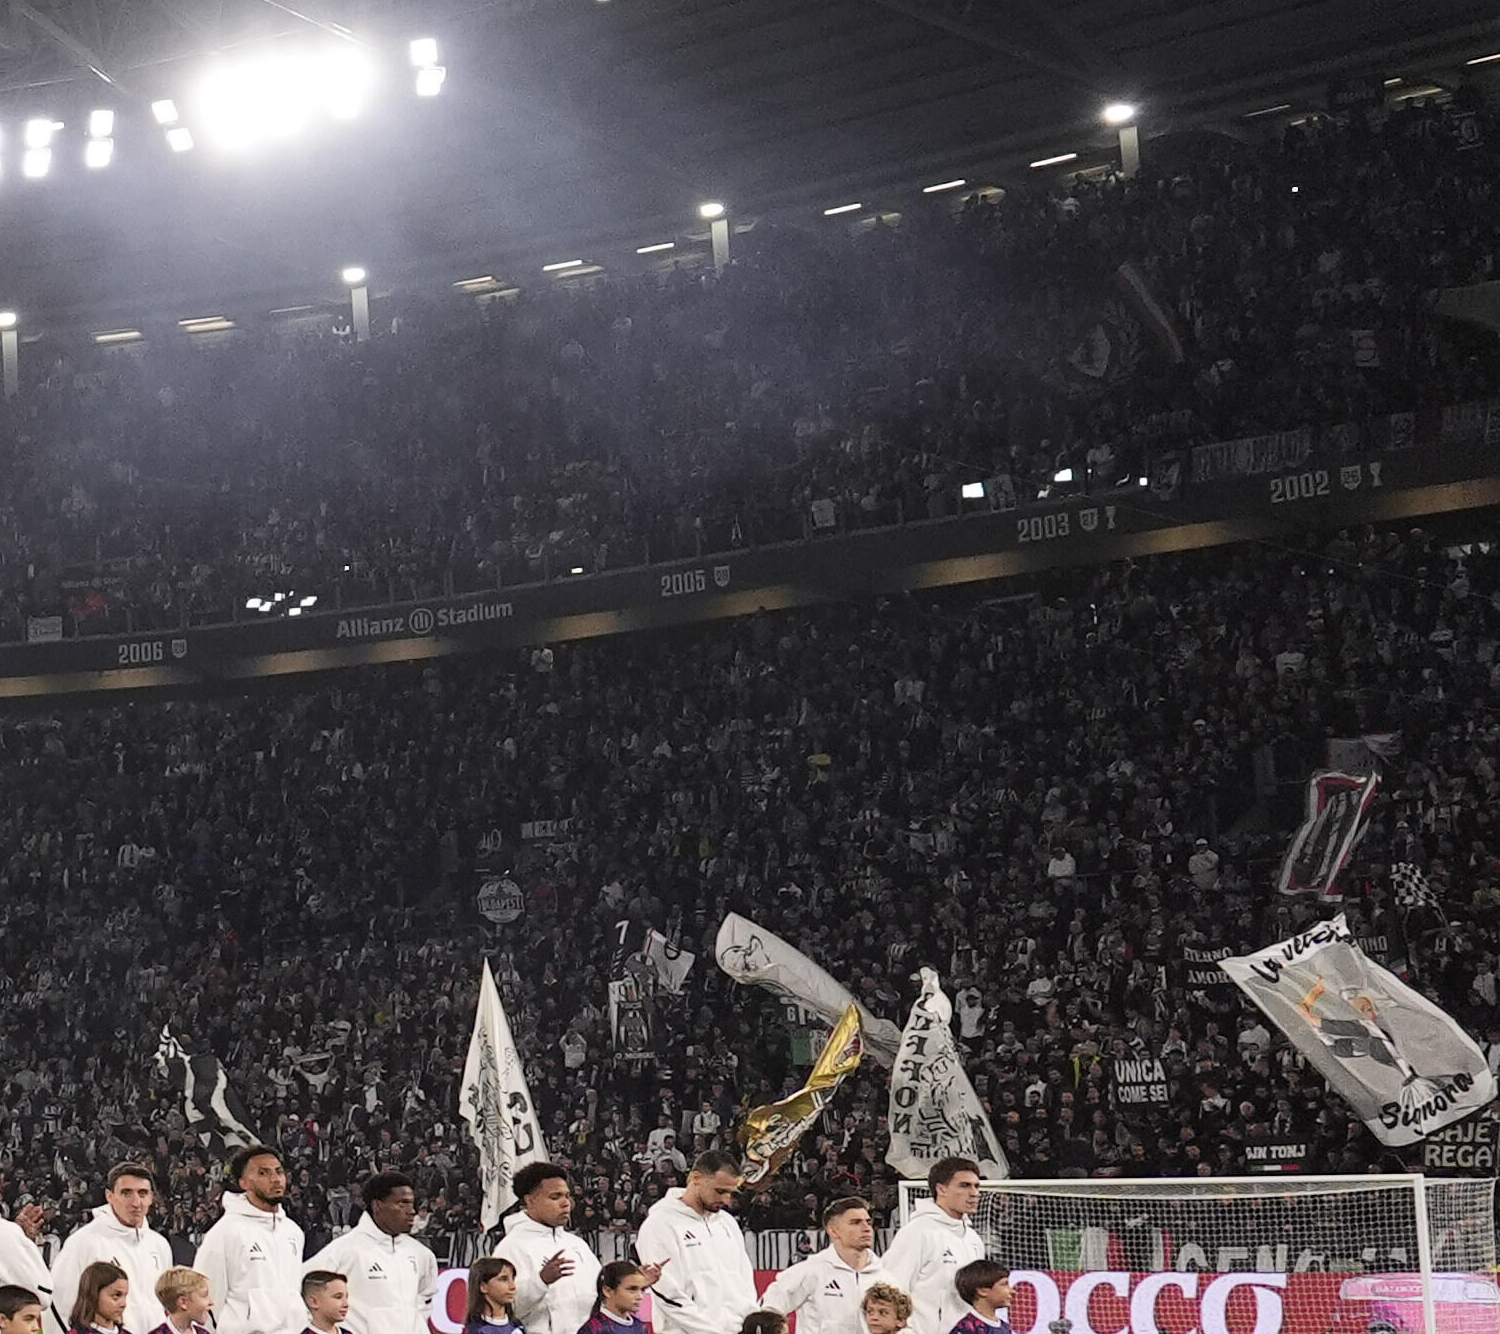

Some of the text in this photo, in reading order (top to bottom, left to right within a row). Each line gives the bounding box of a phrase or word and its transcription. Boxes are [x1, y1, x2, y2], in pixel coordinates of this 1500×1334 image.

[1269, 469, 1331, 503] 2002
[1018, 512, 1070, 543] 2003
[661, 569, 706, 597] 2005
[335, 601, 514, 638] Allianz Stadium
[118, 641, 163, 664] 2006
[1188, 969, 1232, 987] AMOR
[1113, 1058, 1166, 1084] UNICA
[1117, 1084, 1169, 1104] COME SEI
[1379, 1071, 1475, 1138] Signora
